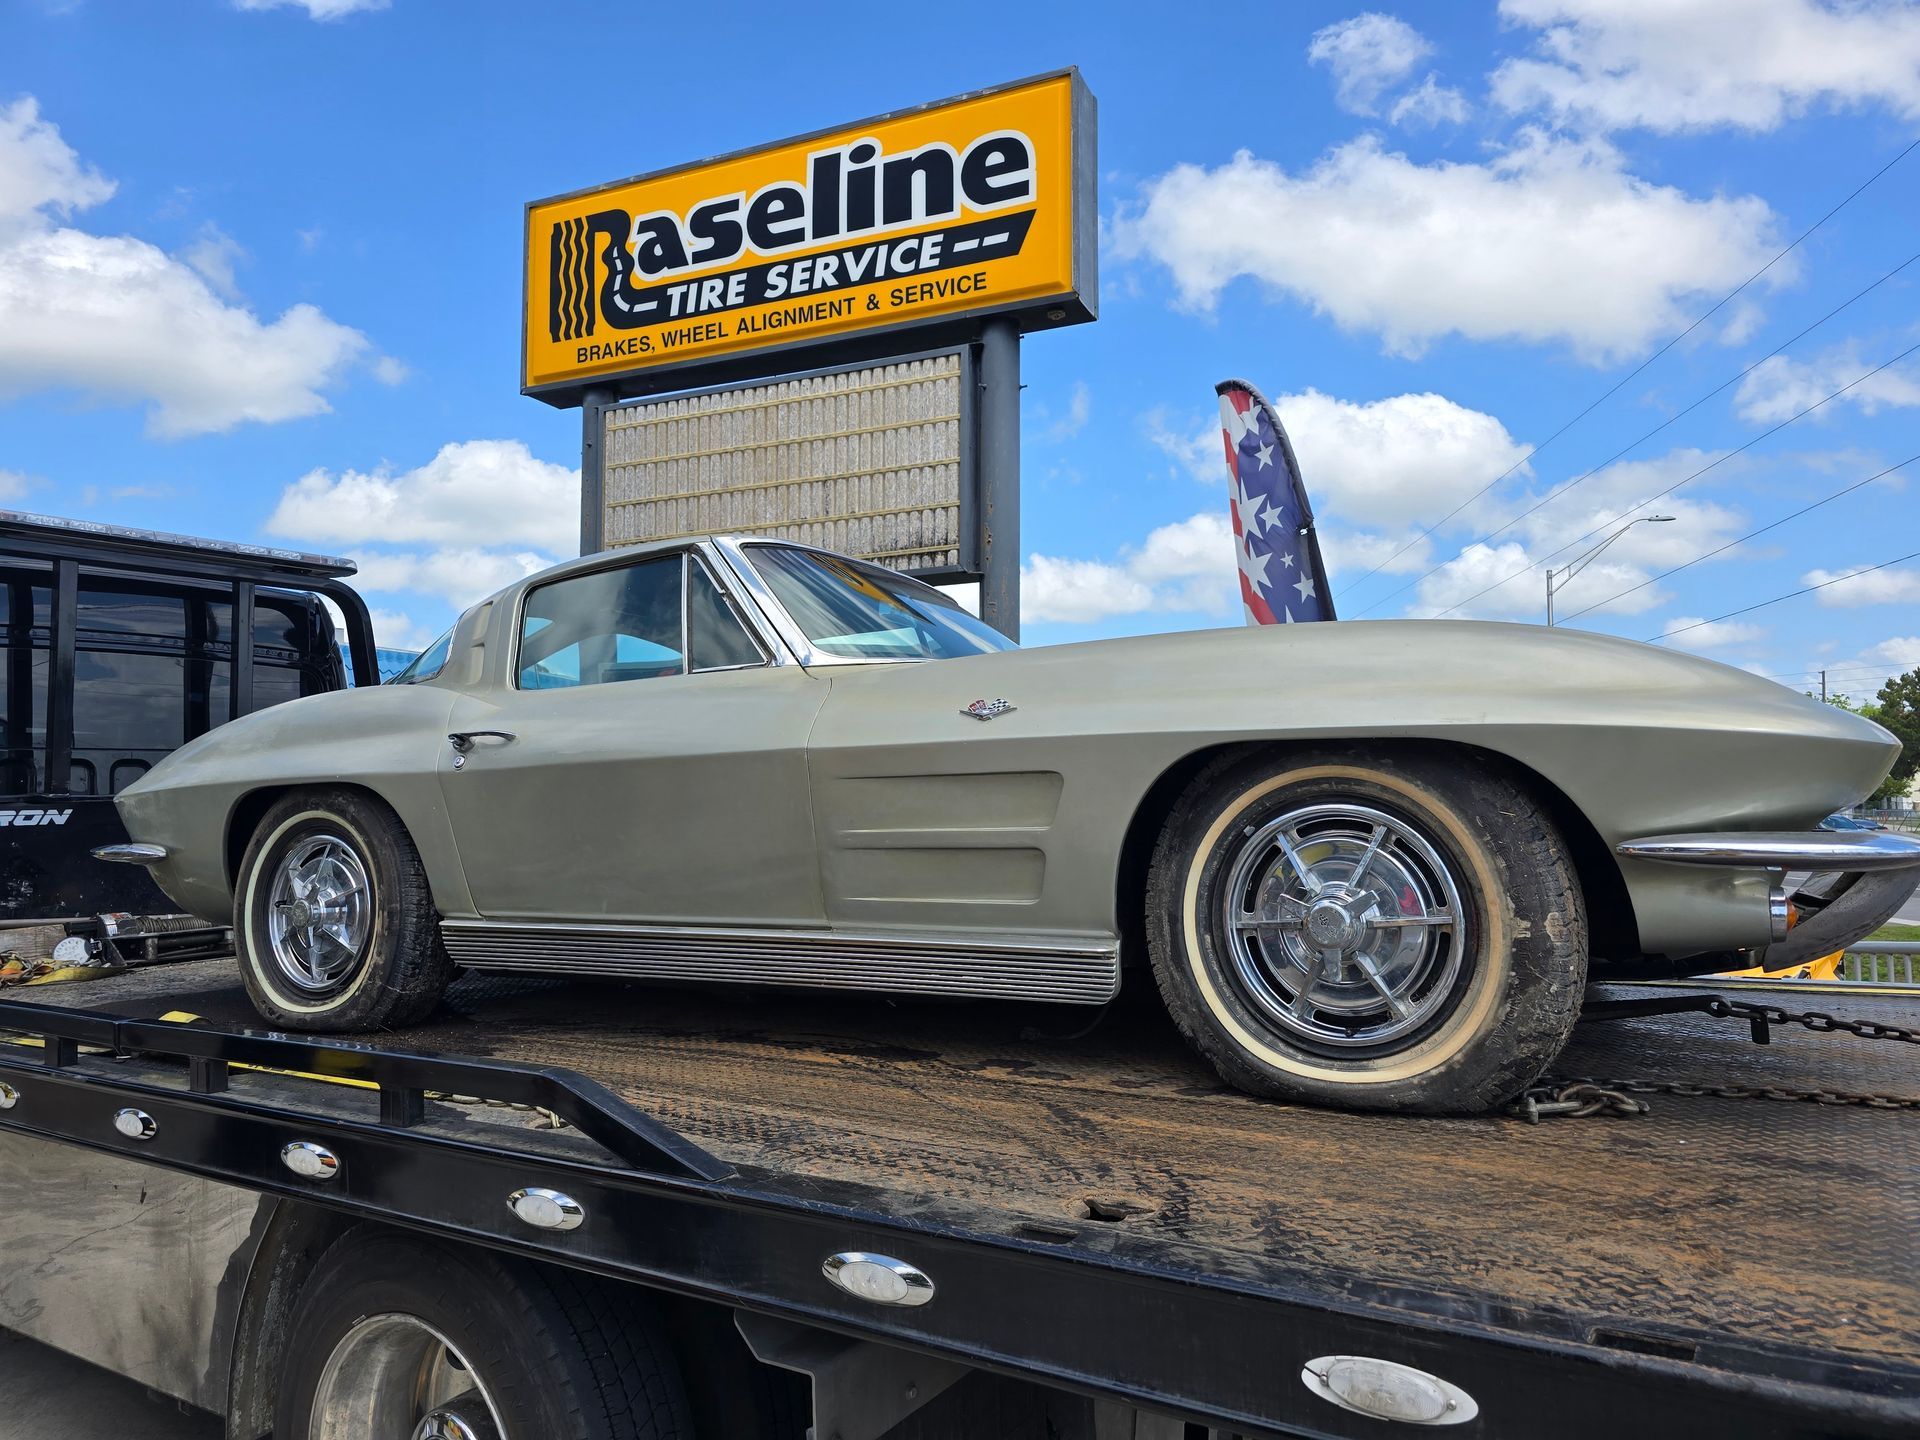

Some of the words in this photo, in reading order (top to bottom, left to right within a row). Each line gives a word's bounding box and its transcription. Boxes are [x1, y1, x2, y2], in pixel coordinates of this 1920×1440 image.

[576, 335, 656, 364] BRAKES,
[661, 322, 729, 348] WHEEL
[736, 297, 856, 335] ALIGNMENT
[865, 293, 880, 311] &
[890, 272, 987, 307] SERVICE
[666, 272, 748, 317] TIRE
[763, 233, 944, 299] SERVICE
